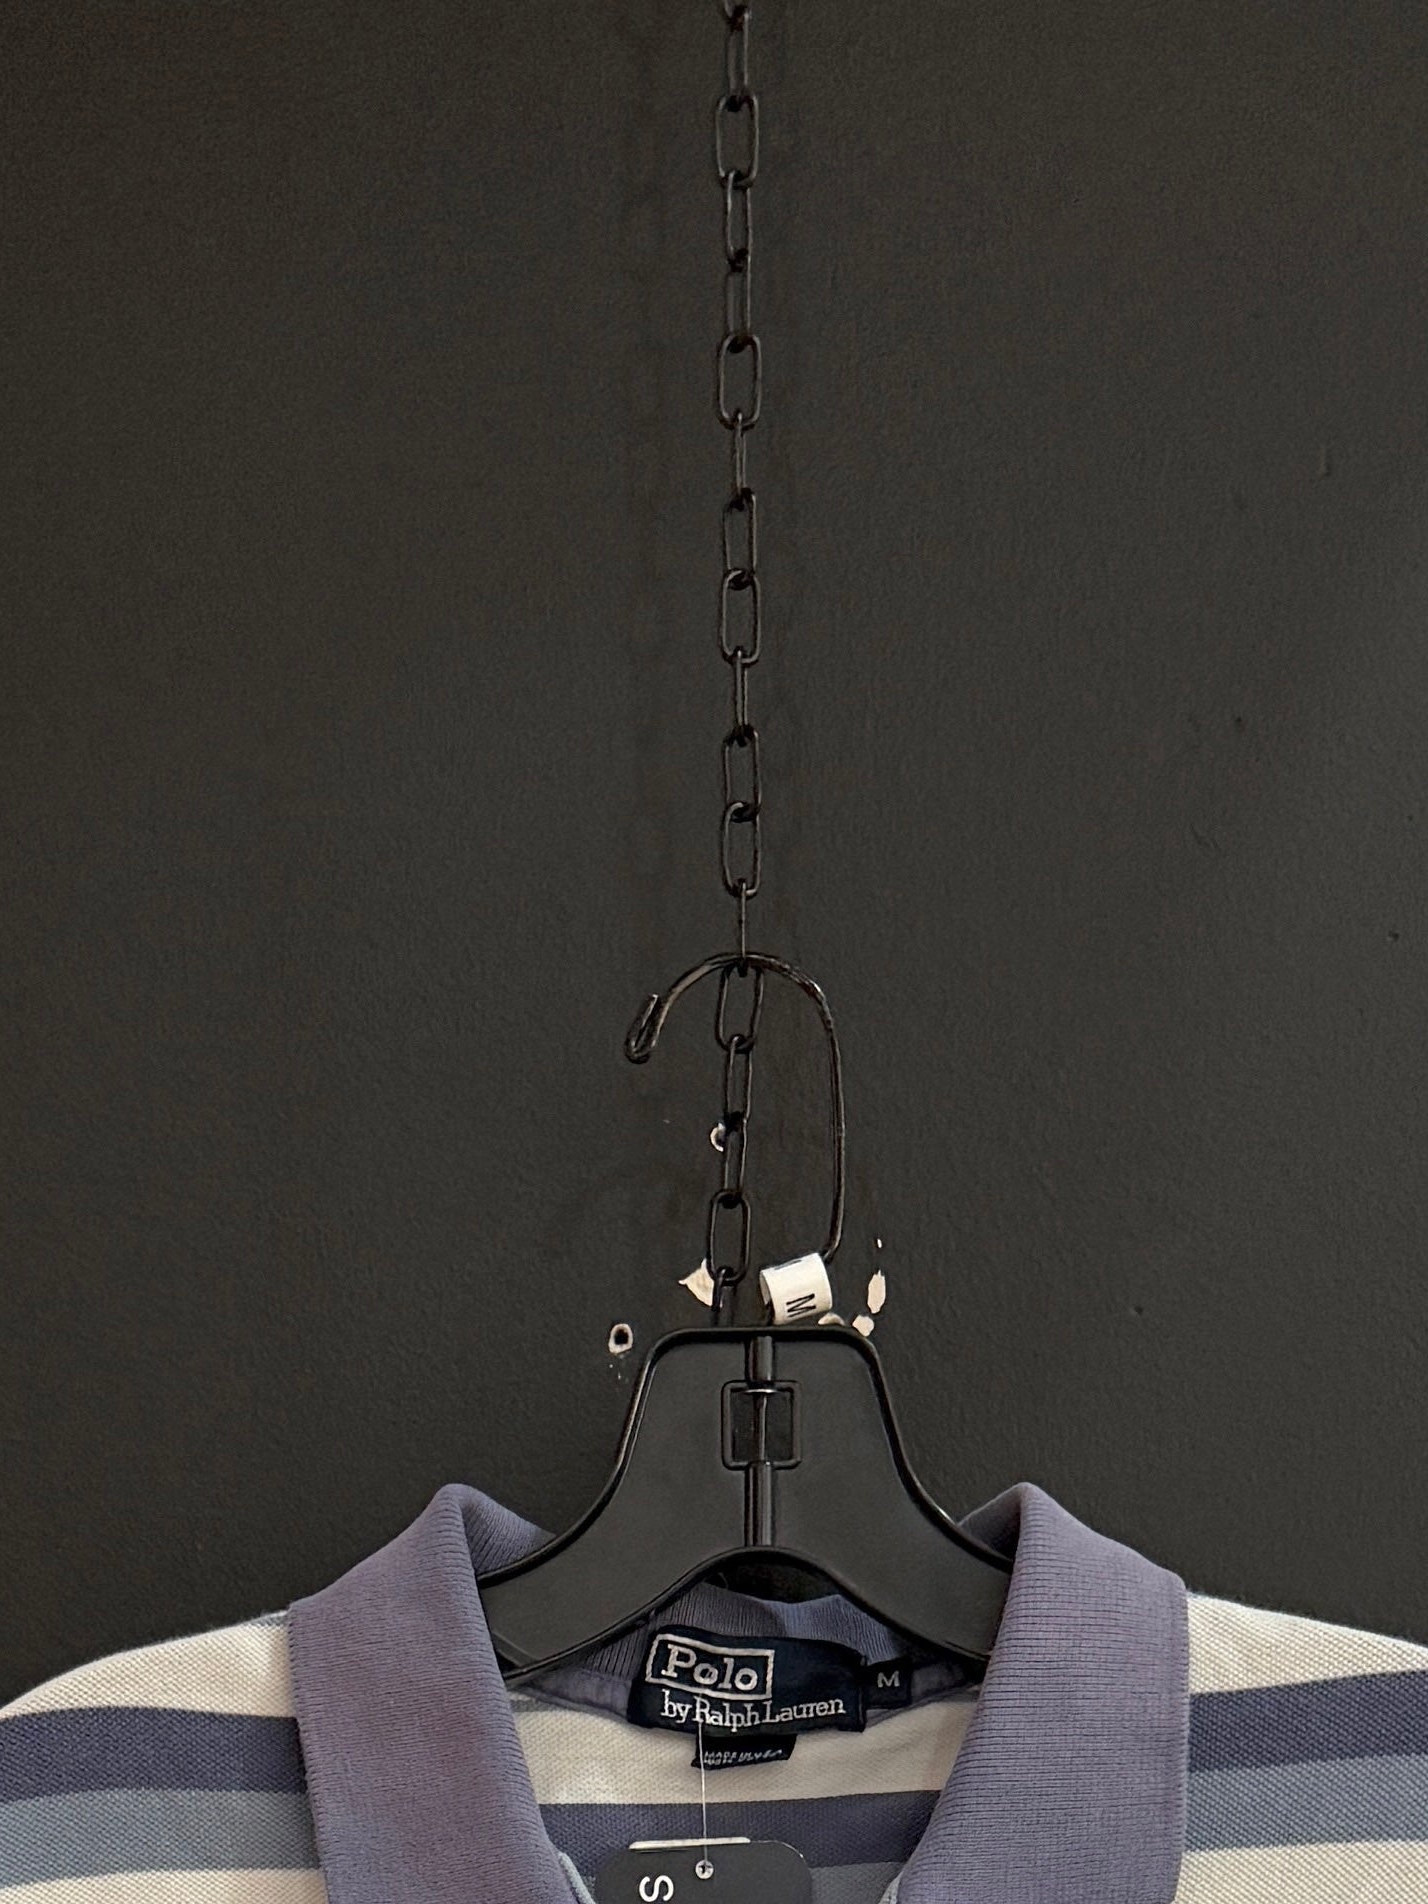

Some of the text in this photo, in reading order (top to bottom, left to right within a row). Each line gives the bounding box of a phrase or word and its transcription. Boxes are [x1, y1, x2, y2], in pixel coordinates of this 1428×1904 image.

[661, 1644, 759, 1691] Polo
[876, 1670, 901, 1688] M
[660, 1690, 847, 1732] by Ralph Lauren
